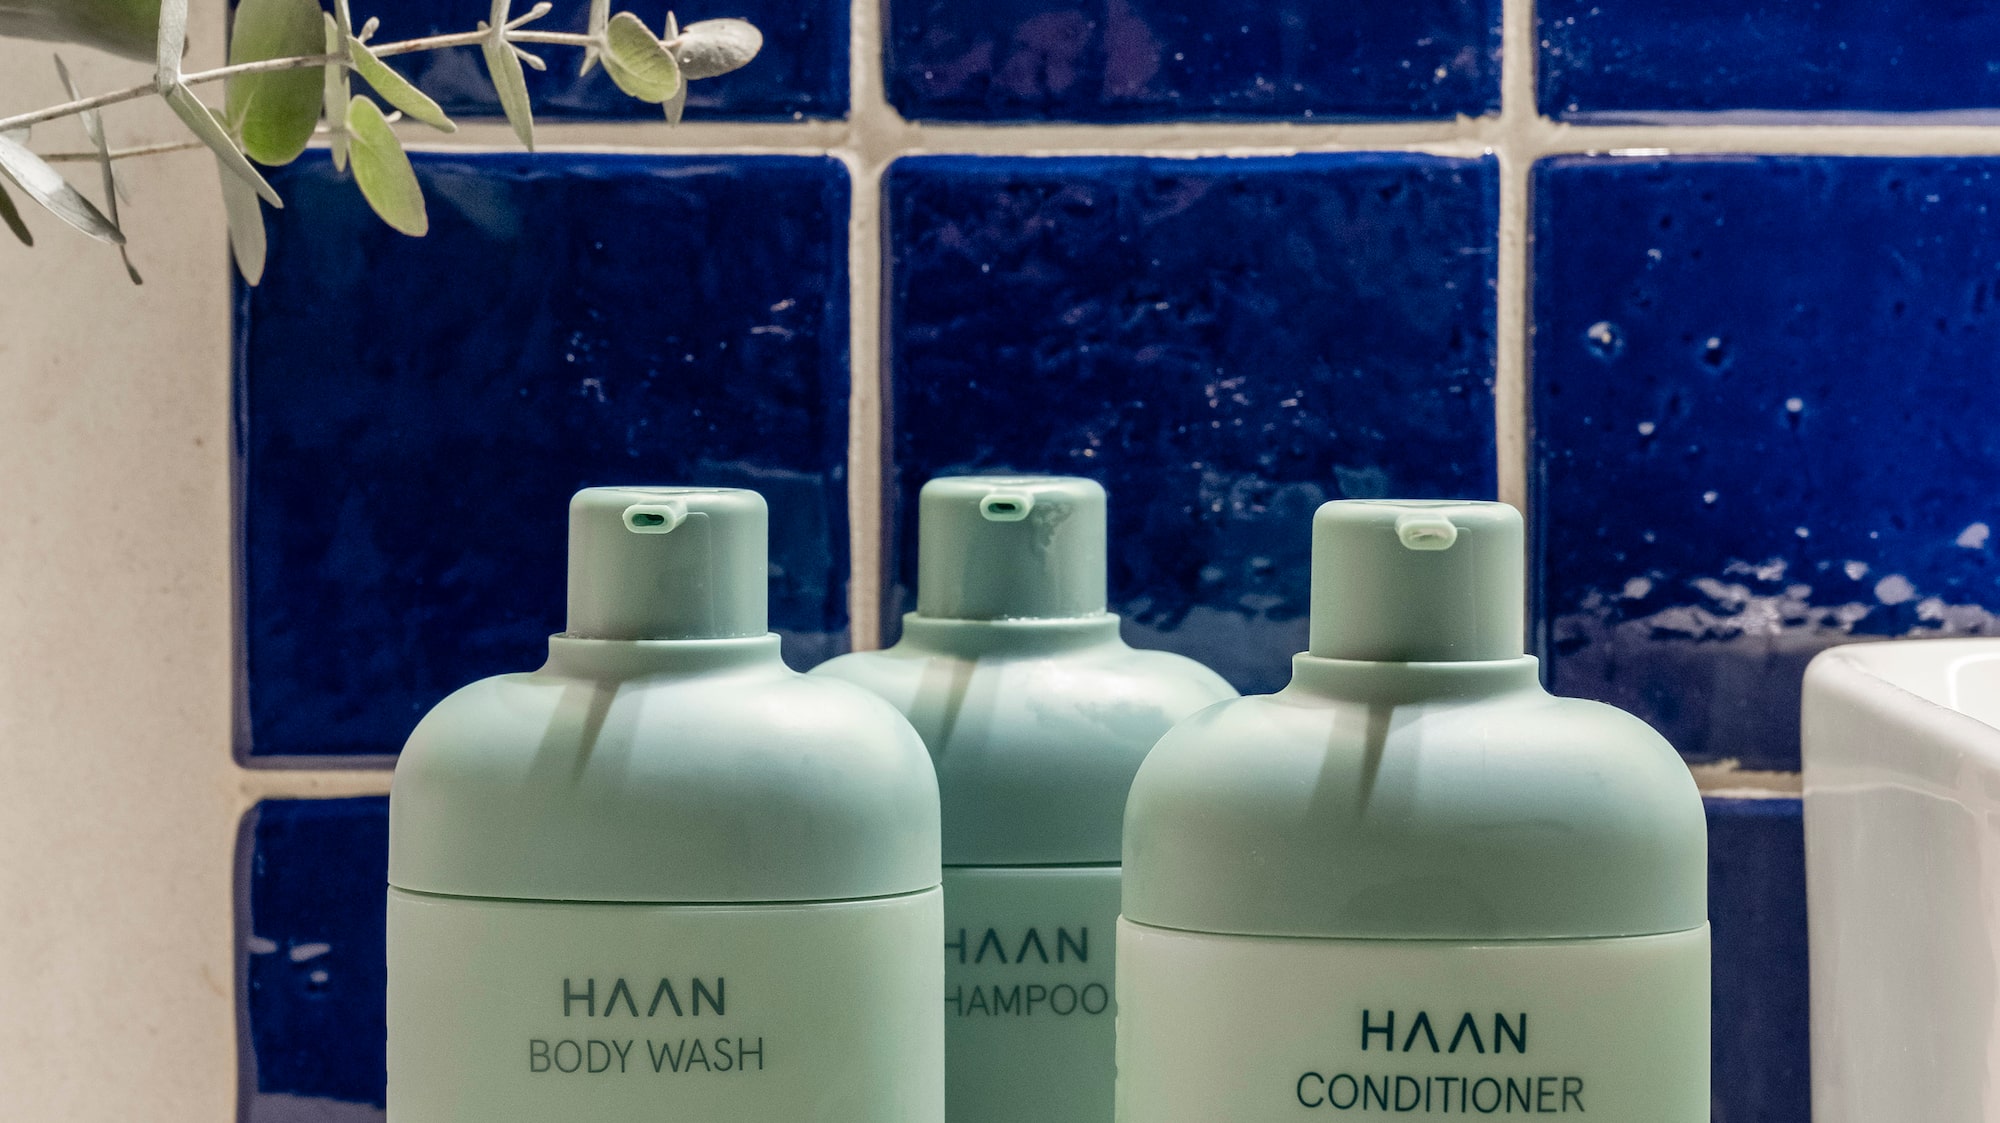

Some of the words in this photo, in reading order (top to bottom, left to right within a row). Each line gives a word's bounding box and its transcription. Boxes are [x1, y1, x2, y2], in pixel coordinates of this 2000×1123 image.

[563, 977, 725, 1017] HAAN
[945, 983, 1108, 1016] HAMPOO
[1361, 1009, 1527, 1054] HAAN
[529, 1039, 634, 1073] BODY
[646, 1037, 763, 1073] WASH
[1296, 1072, 1585, 1114] CONDITIONER
